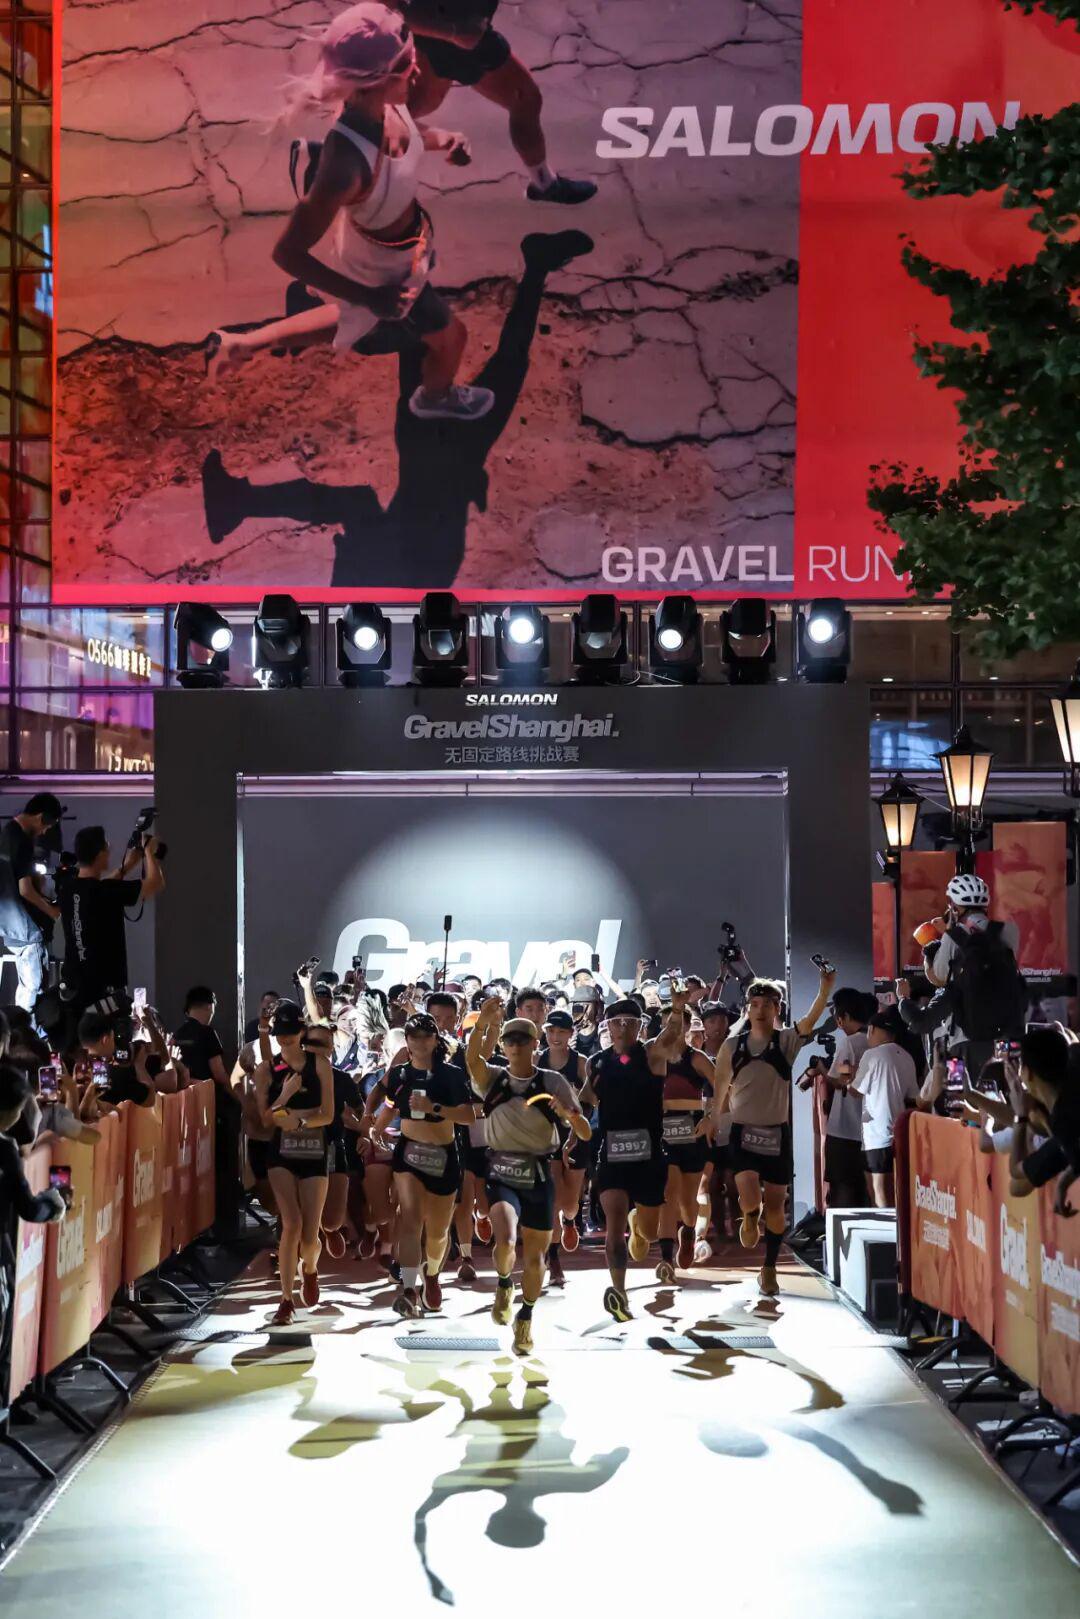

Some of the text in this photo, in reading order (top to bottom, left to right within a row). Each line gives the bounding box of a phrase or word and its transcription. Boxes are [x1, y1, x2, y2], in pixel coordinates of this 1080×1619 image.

[595, 101, 1021, 159] SALOMON
[601, 545, 795, 584] GRAVEL
[465, 694, 558, 706] SALOMON
[404, 713, 620, 743] GravelShanghai.
[444, 746, 580, 764] 无固定路线挑战赛
